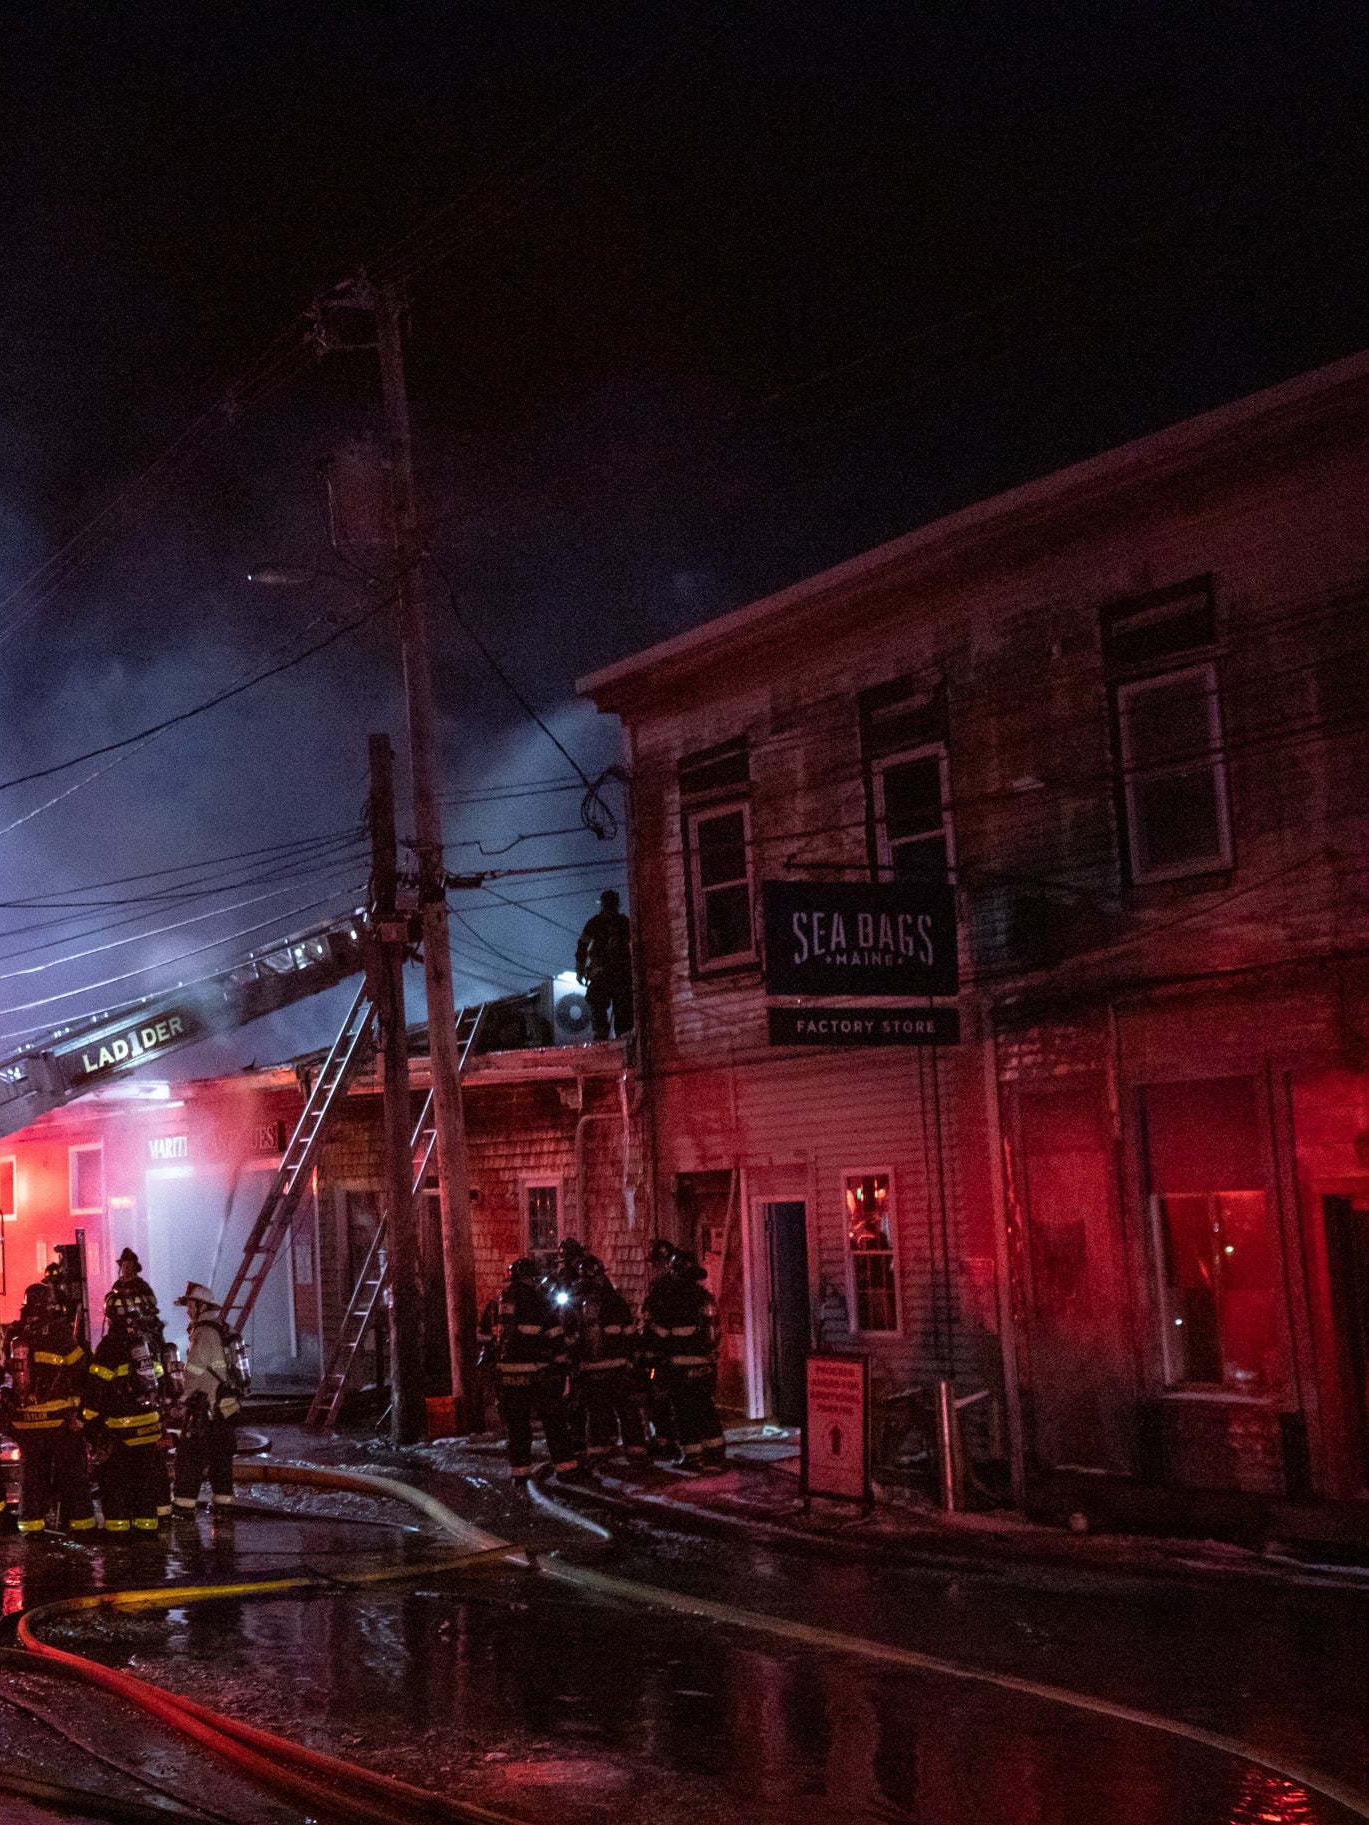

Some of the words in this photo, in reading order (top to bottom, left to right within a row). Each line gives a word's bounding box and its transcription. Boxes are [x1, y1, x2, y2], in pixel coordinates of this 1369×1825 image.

[792, 912, 847, 965] SEA
[857, 912, 933, 967] BAGS
[835, 951, 894, 966] MAINE
[796, 1020, 875, 1033] FACTORY
[882, 1020, 936, 1033] STORE
